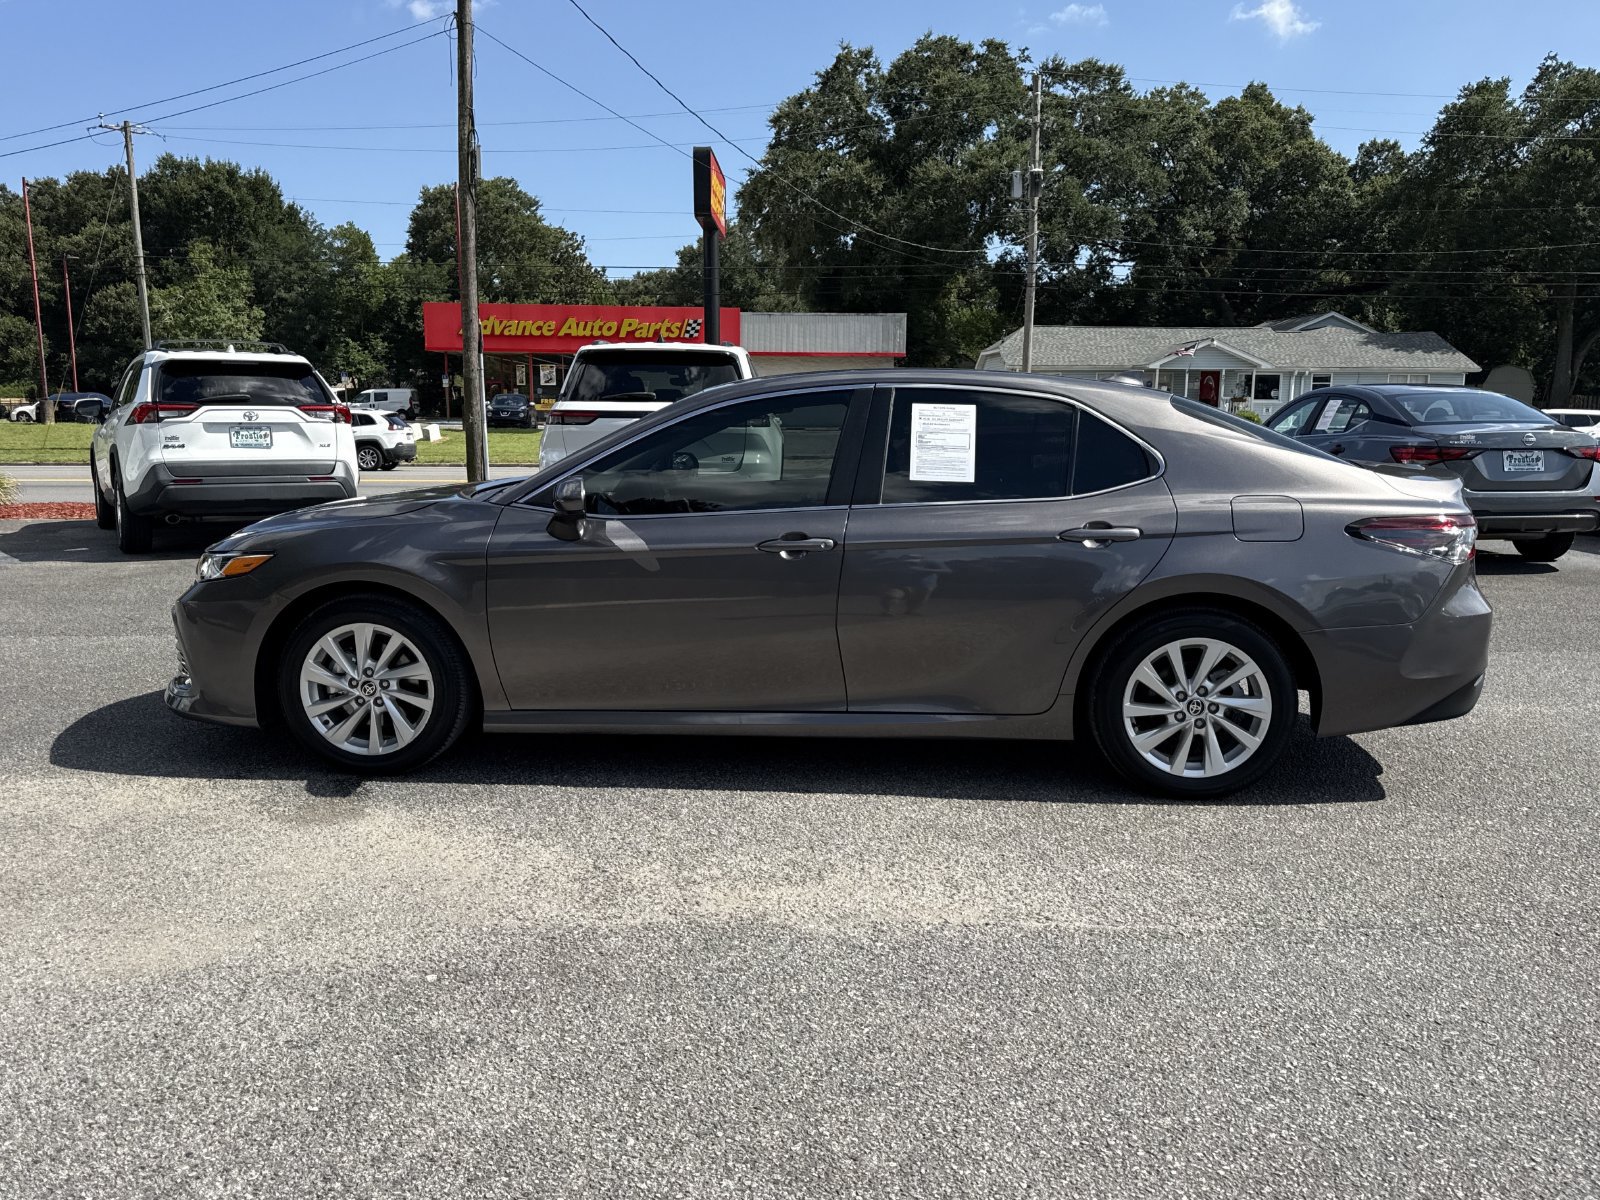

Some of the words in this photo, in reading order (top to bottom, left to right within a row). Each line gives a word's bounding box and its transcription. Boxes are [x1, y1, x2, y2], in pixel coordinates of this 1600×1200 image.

[458, 315, 556, 336] dvance
[558, 316, 618, 337] Auto
[619, 318, 681, 338] Parts
